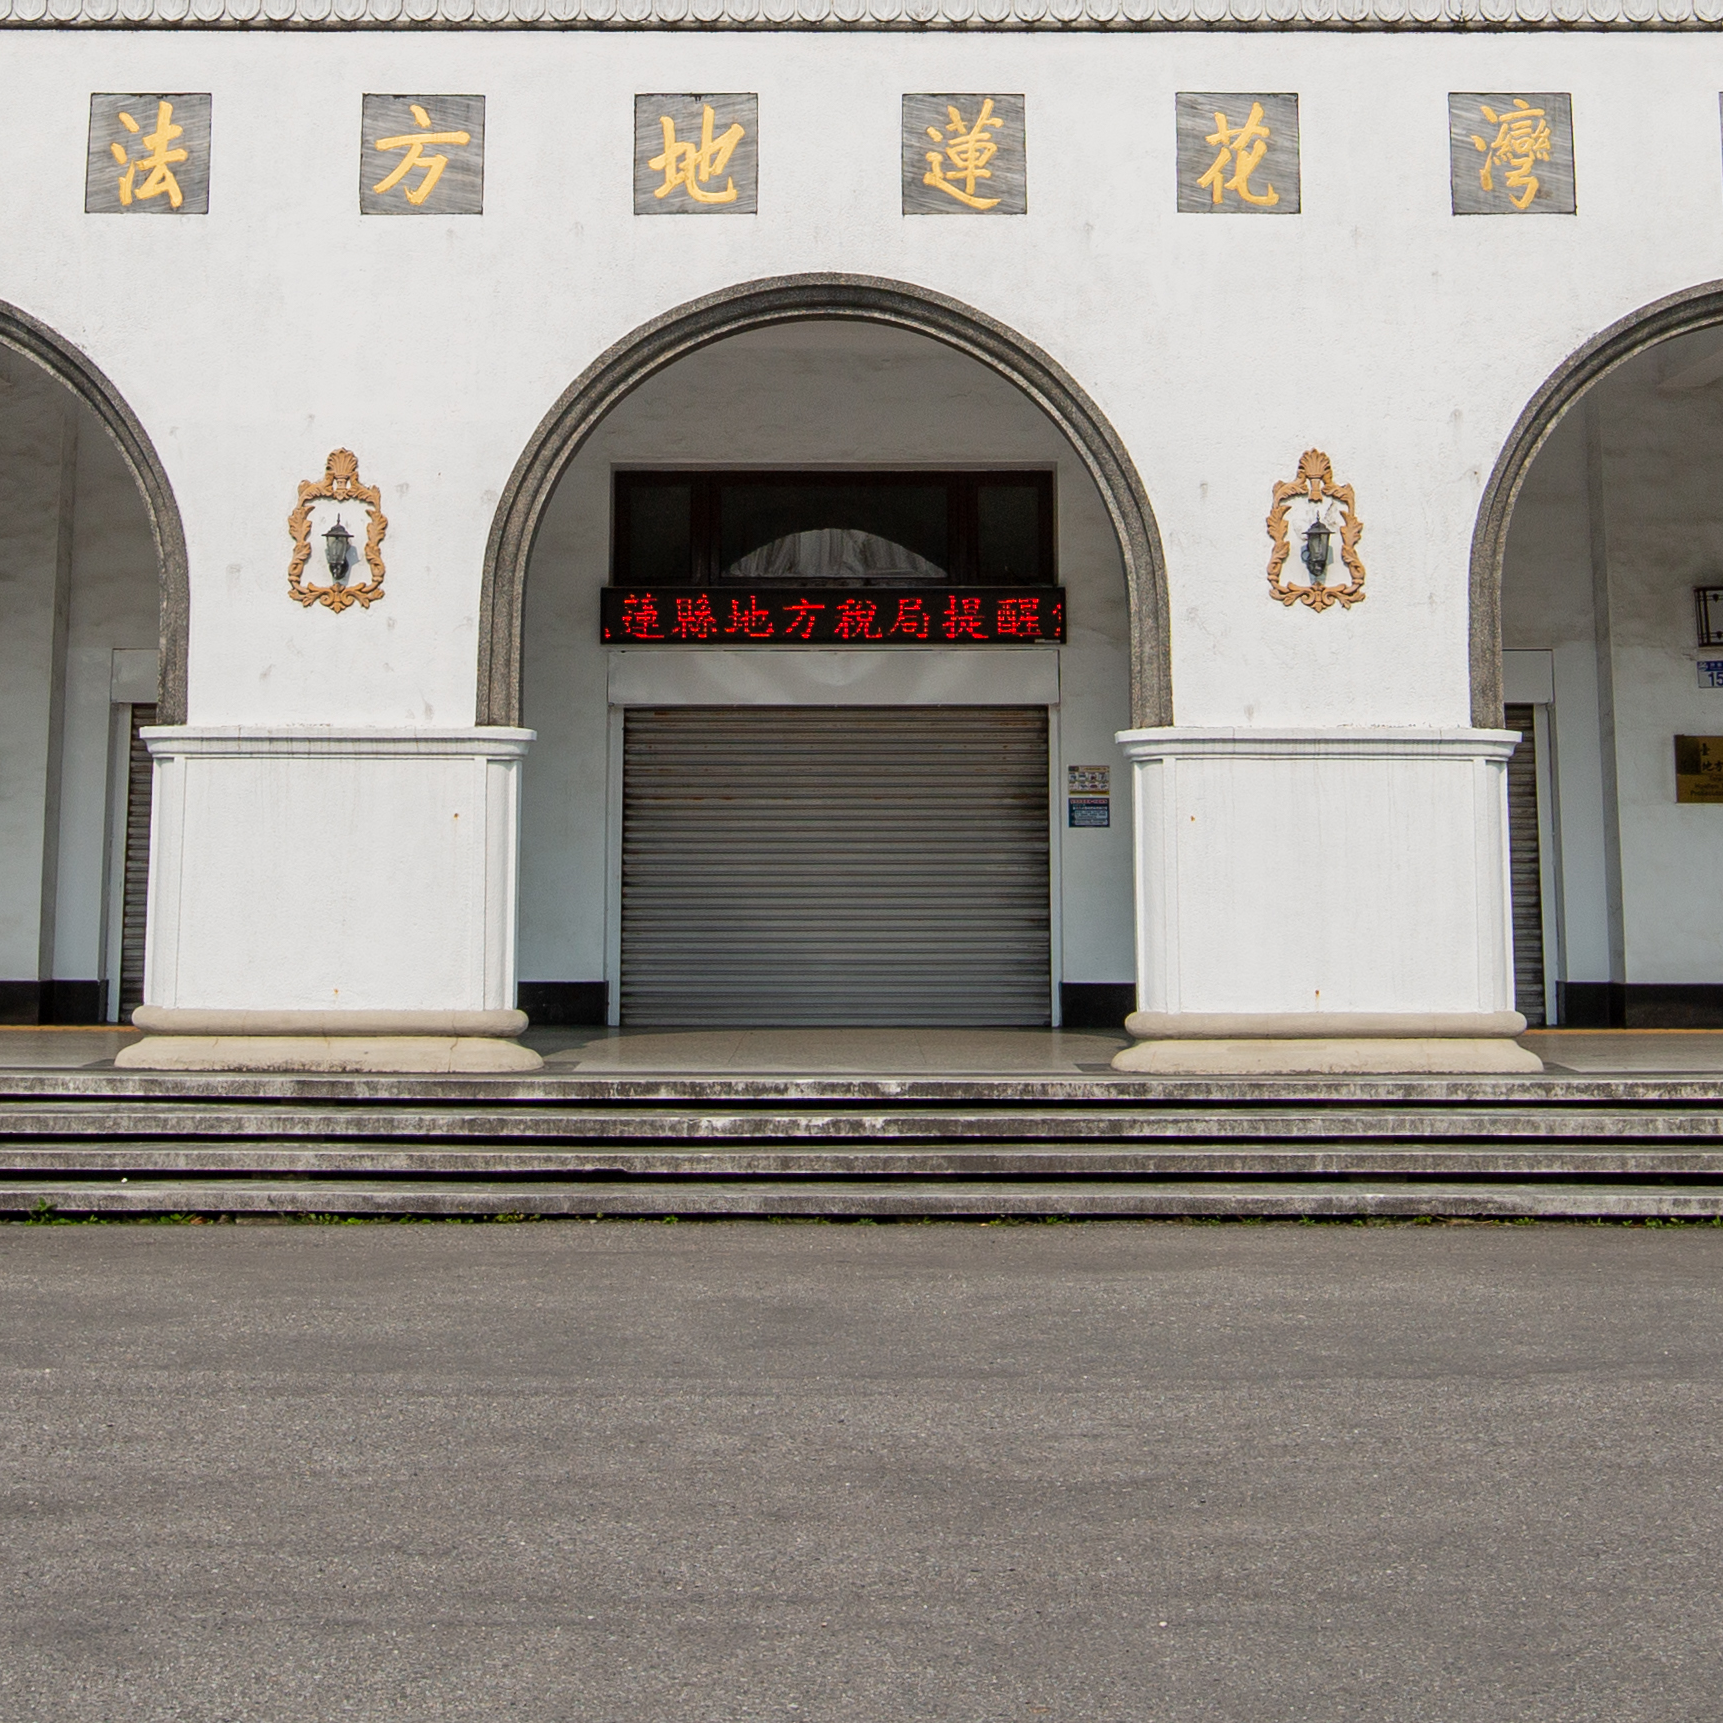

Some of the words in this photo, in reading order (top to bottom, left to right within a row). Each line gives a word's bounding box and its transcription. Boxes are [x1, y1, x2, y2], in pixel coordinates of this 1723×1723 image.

[605, 593, 1061, 638] 蓮縣地方稅局提醒
